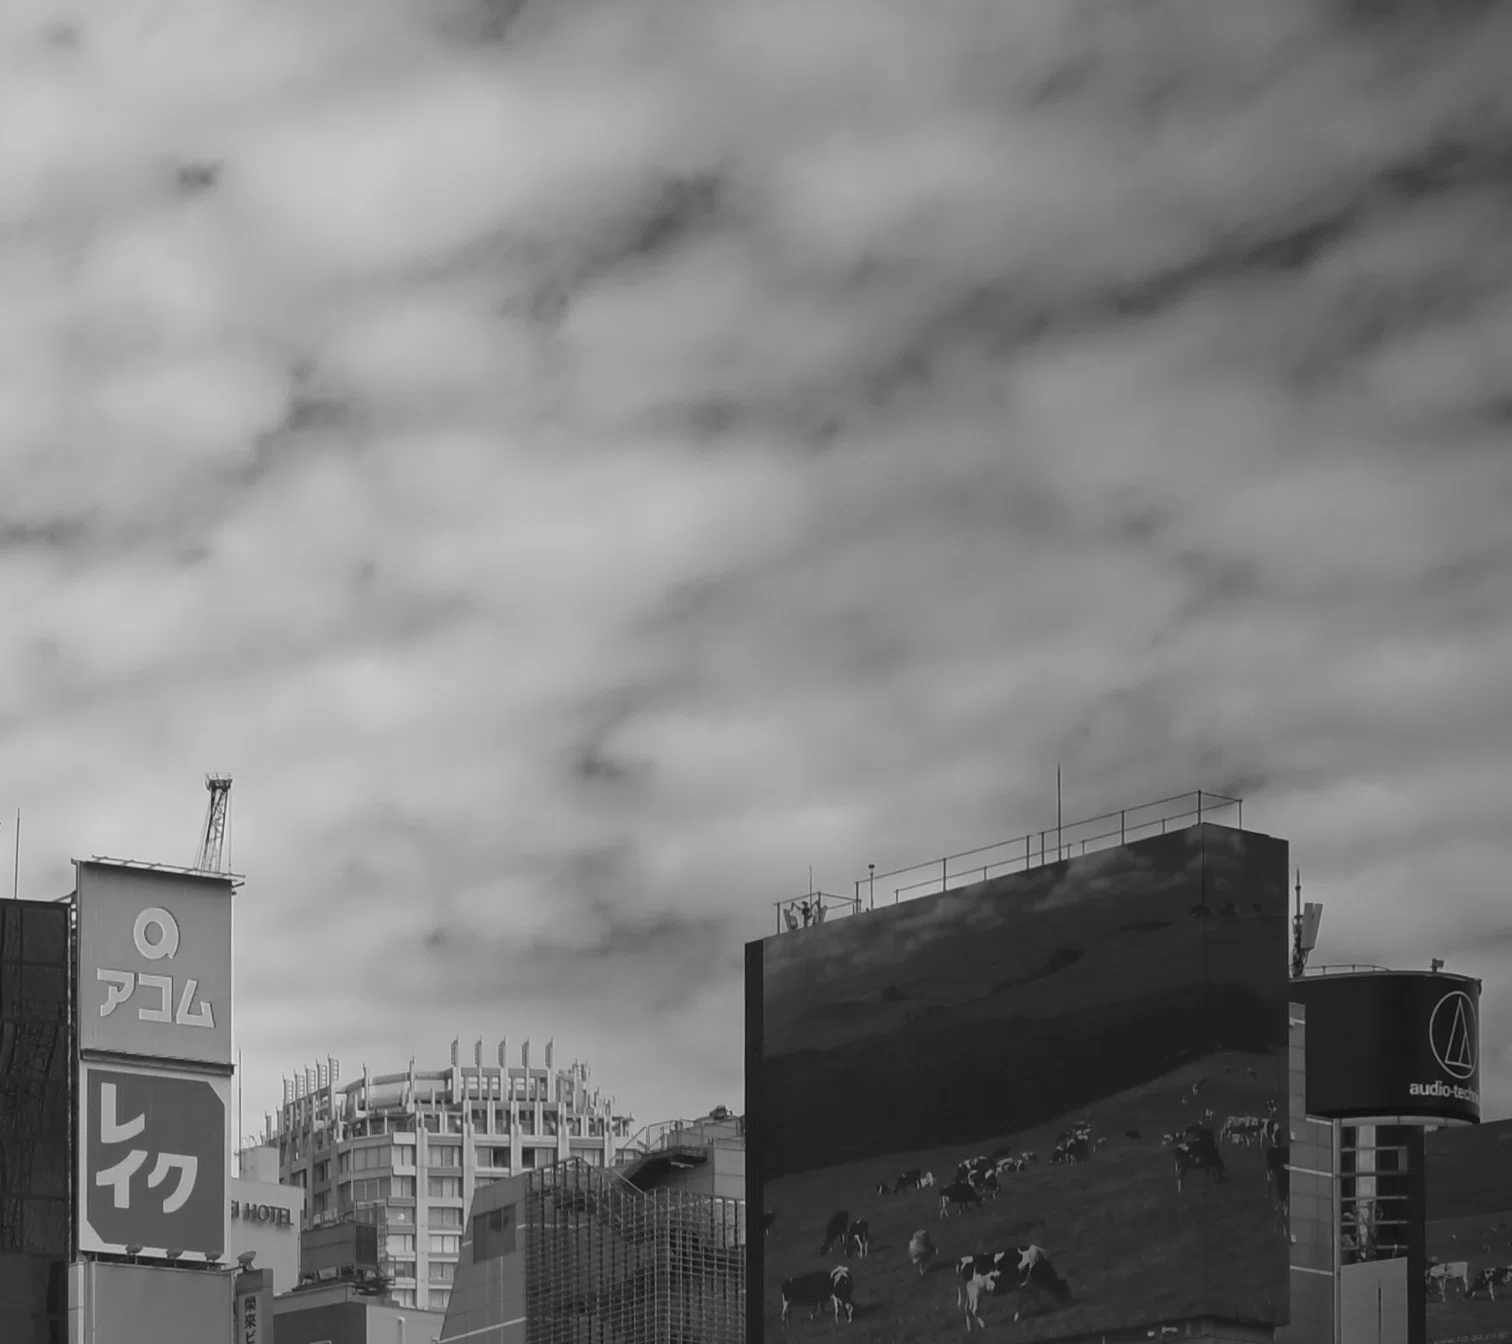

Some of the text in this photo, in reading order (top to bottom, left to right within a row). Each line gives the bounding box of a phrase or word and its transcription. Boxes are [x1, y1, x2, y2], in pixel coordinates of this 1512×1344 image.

[97, 968, 215, 1028] アコム
[96, 1082, 198, 1213] レイク
[246, 1203, 294, 1225] HOTEL
